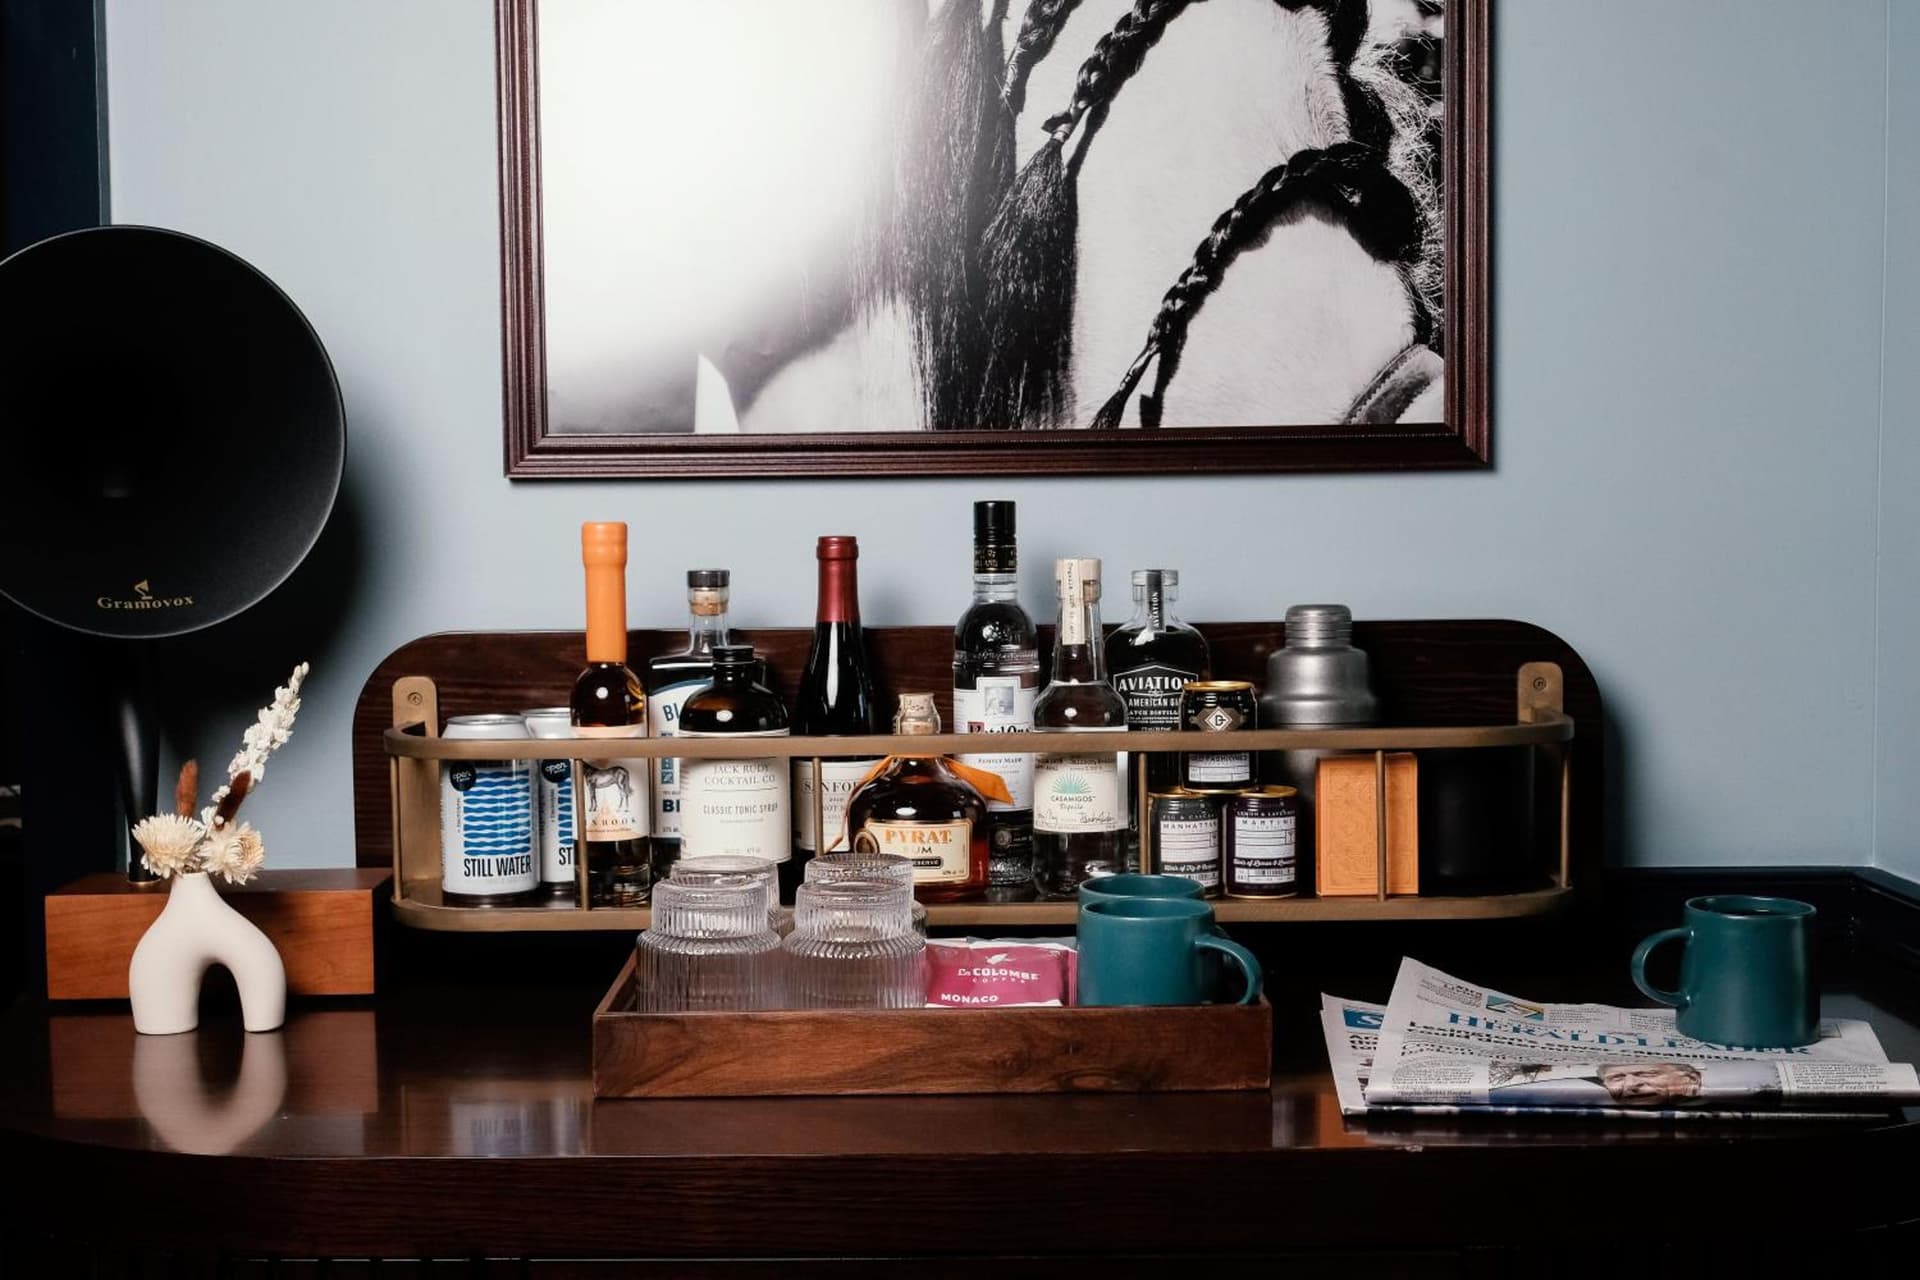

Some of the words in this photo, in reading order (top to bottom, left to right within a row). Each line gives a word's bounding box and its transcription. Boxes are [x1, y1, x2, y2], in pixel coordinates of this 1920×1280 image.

[97, 596, 194, 609] Gramovox
[1151, 592, 1160, 628] AVIATION
[1128, 698, 1168, 707] AMERICAN
[713, 764, 740, 774] JACK
[704, 775, 759, 785] COCKTAIL
[703, 804, 733, 814] CLASSIC
[735, 803, 758, 814] TONIC
[1162, 820, 1217, 830] MANHATTAN
[1241, 818, 1293, 826] MARTINI
[884, 829, 952, 845] PYRAT
[463, 858, 494, 878] STILL
[496, 854, 532, 876] WATER
[972, 967, 1041, 981] COLOMBE
[940, 992, 999, 1004] MONACO
